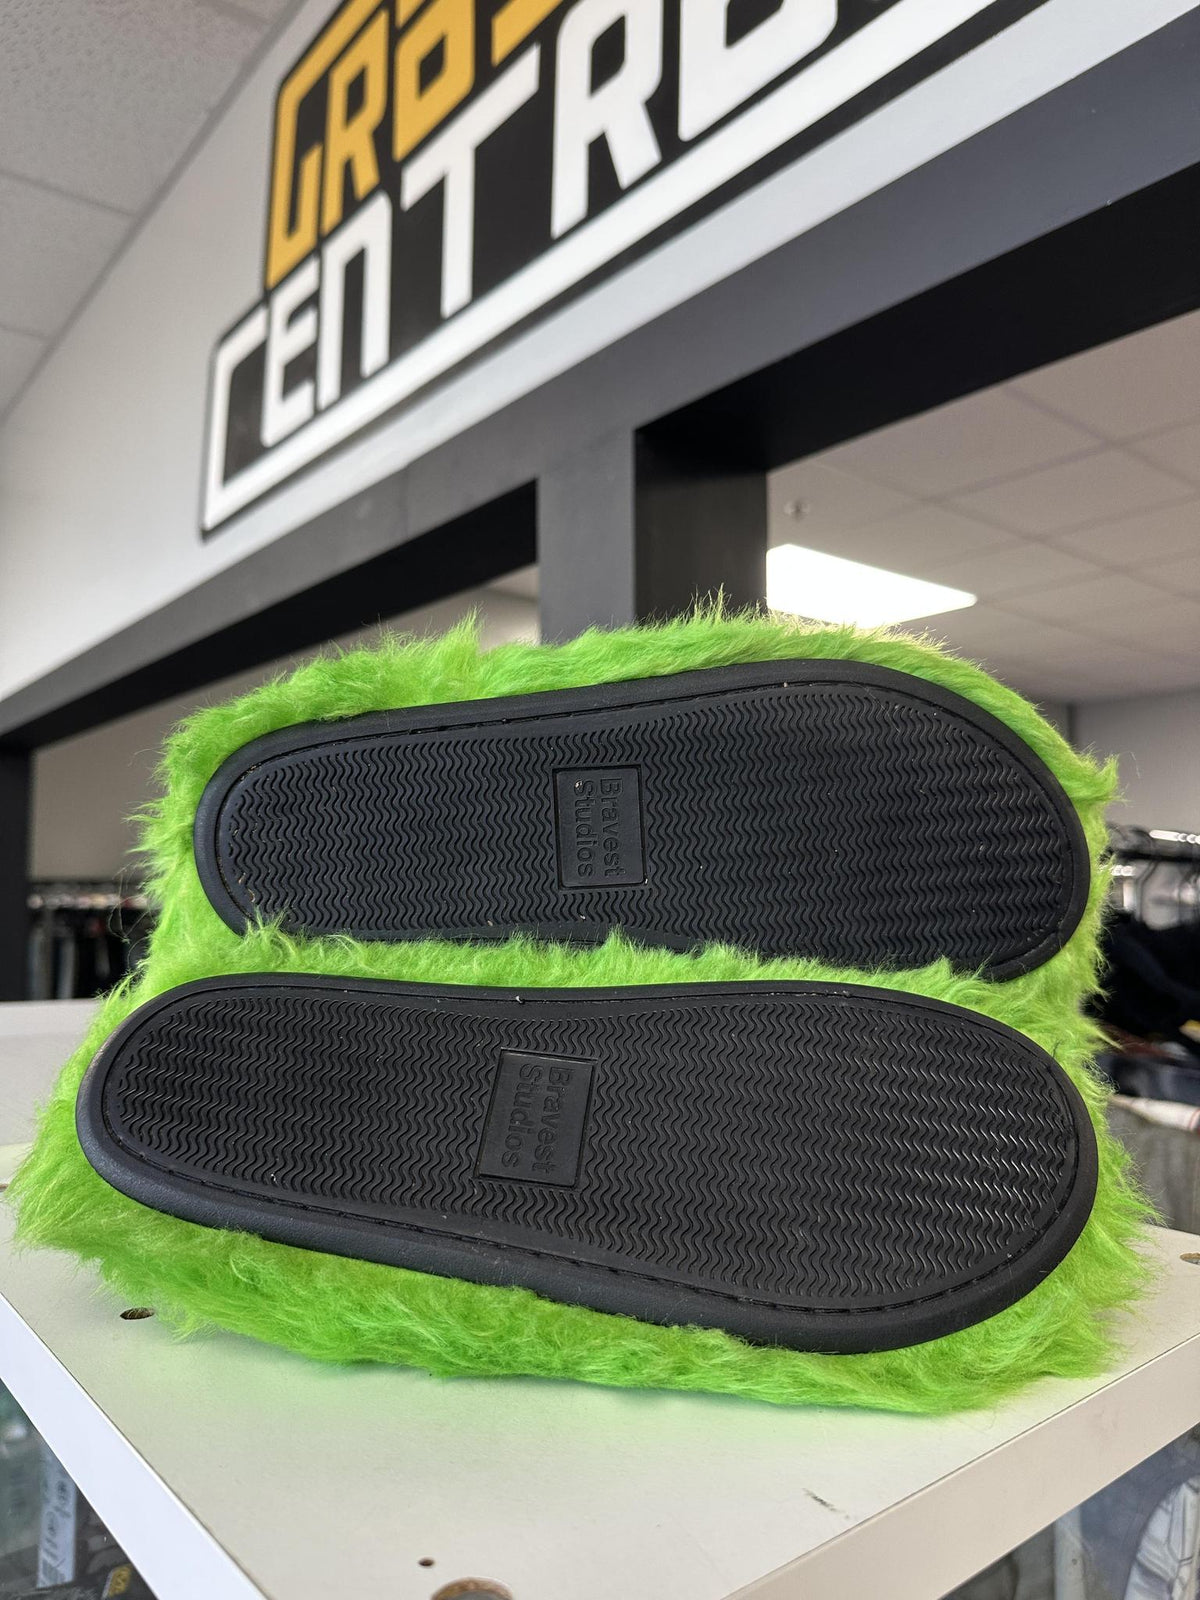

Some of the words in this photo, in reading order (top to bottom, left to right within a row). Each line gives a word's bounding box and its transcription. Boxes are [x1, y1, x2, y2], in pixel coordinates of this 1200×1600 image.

[573, 779, 597, 878] Studios
[600, 777, 625, 877] Bravest
[501, 1063, 544, 1168] Studios
[531, 1066, 575, 1174] Bravest
